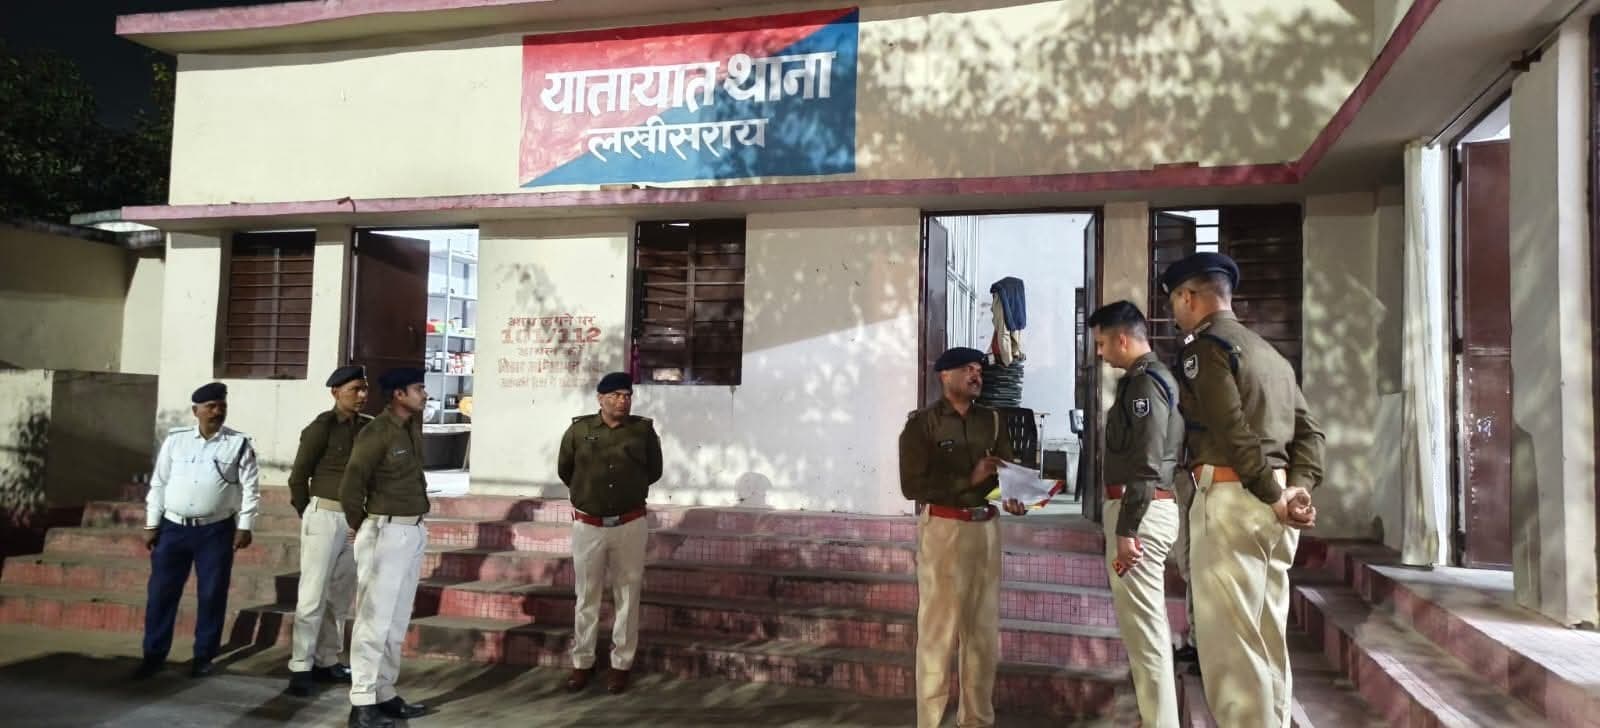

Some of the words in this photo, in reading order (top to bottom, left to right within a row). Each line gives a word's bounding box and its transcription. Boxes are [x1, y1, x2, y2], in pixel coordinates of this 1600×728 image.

[540, 61, 720, 116] यातायात
[723, 51, 837, 103] थाना
[586, 116, 769, 162] लखीसराय
